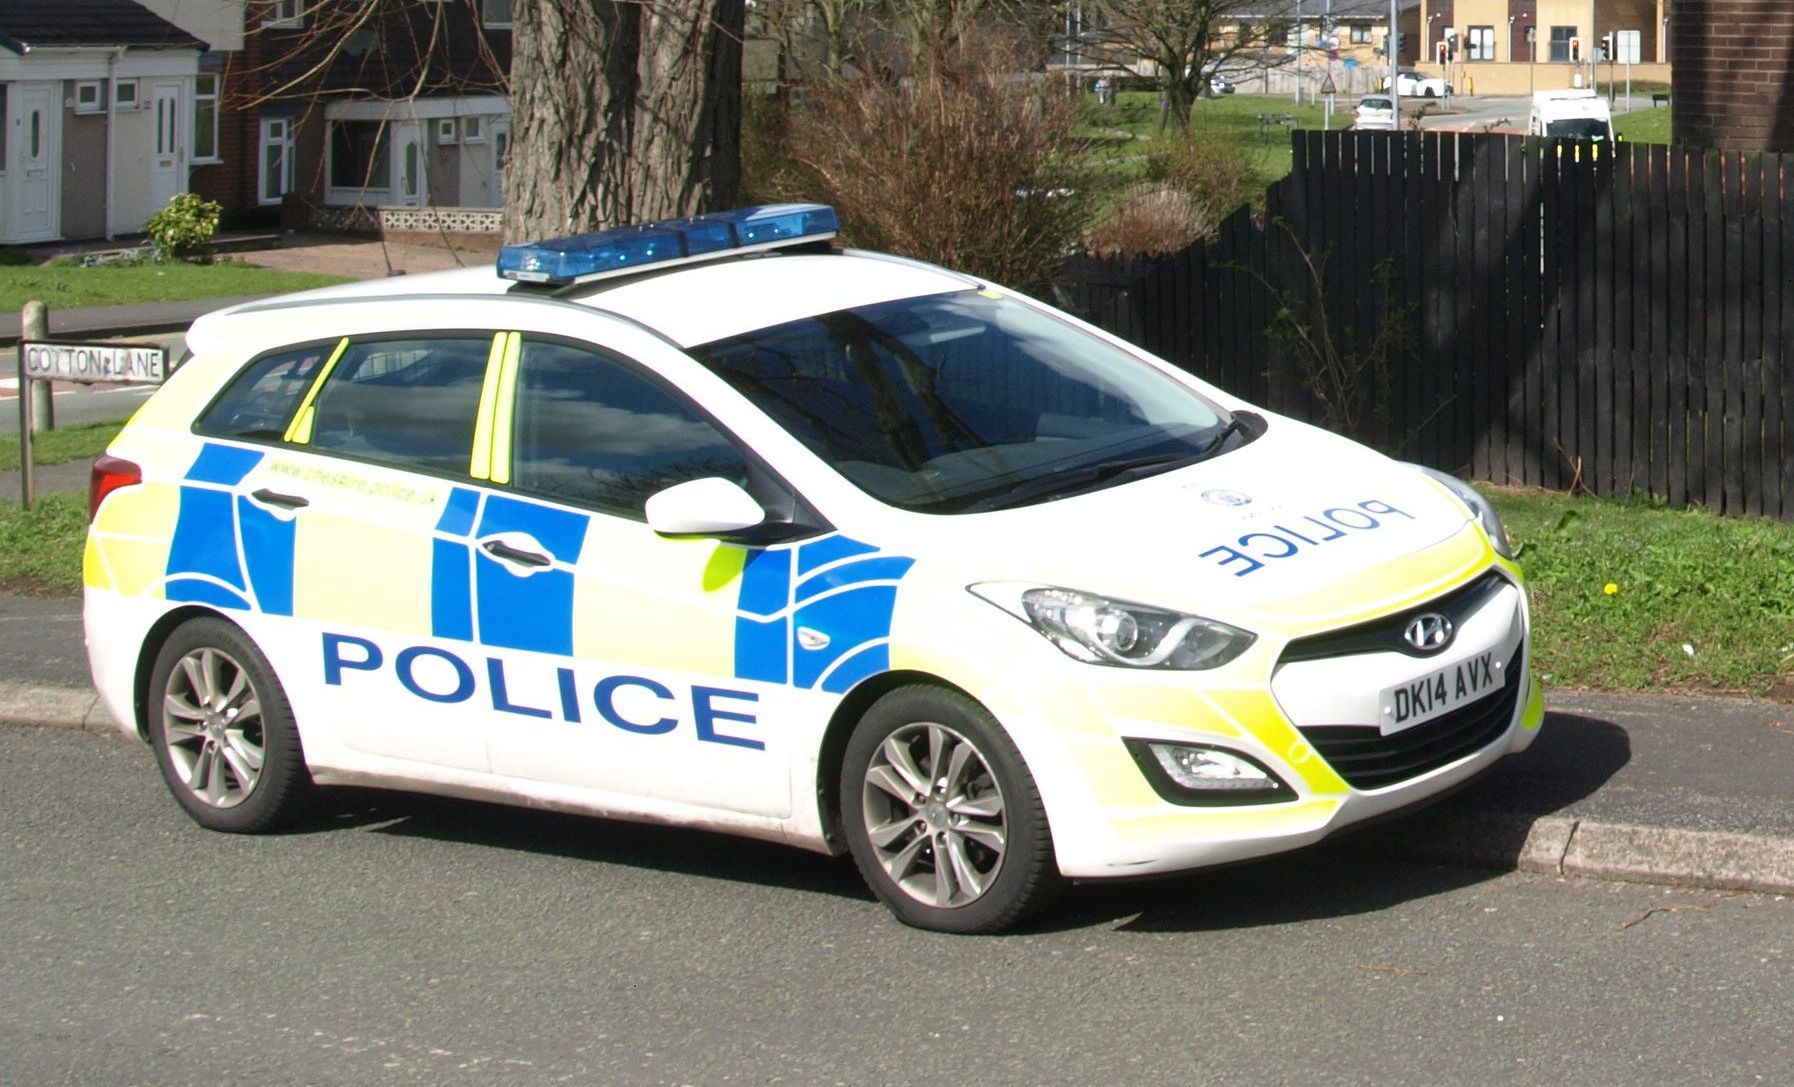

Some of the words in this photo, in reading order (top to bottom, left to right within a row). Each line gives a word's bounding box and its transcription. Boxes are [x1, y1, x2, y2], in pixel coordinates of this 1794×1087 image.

[27, 347, 100, 374] COTTON
[112, 351, 159, 377] LANE
[322, 632, 766, 751] POLICE
[1394, 672, 1448, 724] DK14
[1455, 651, 1494, 700] AVX
